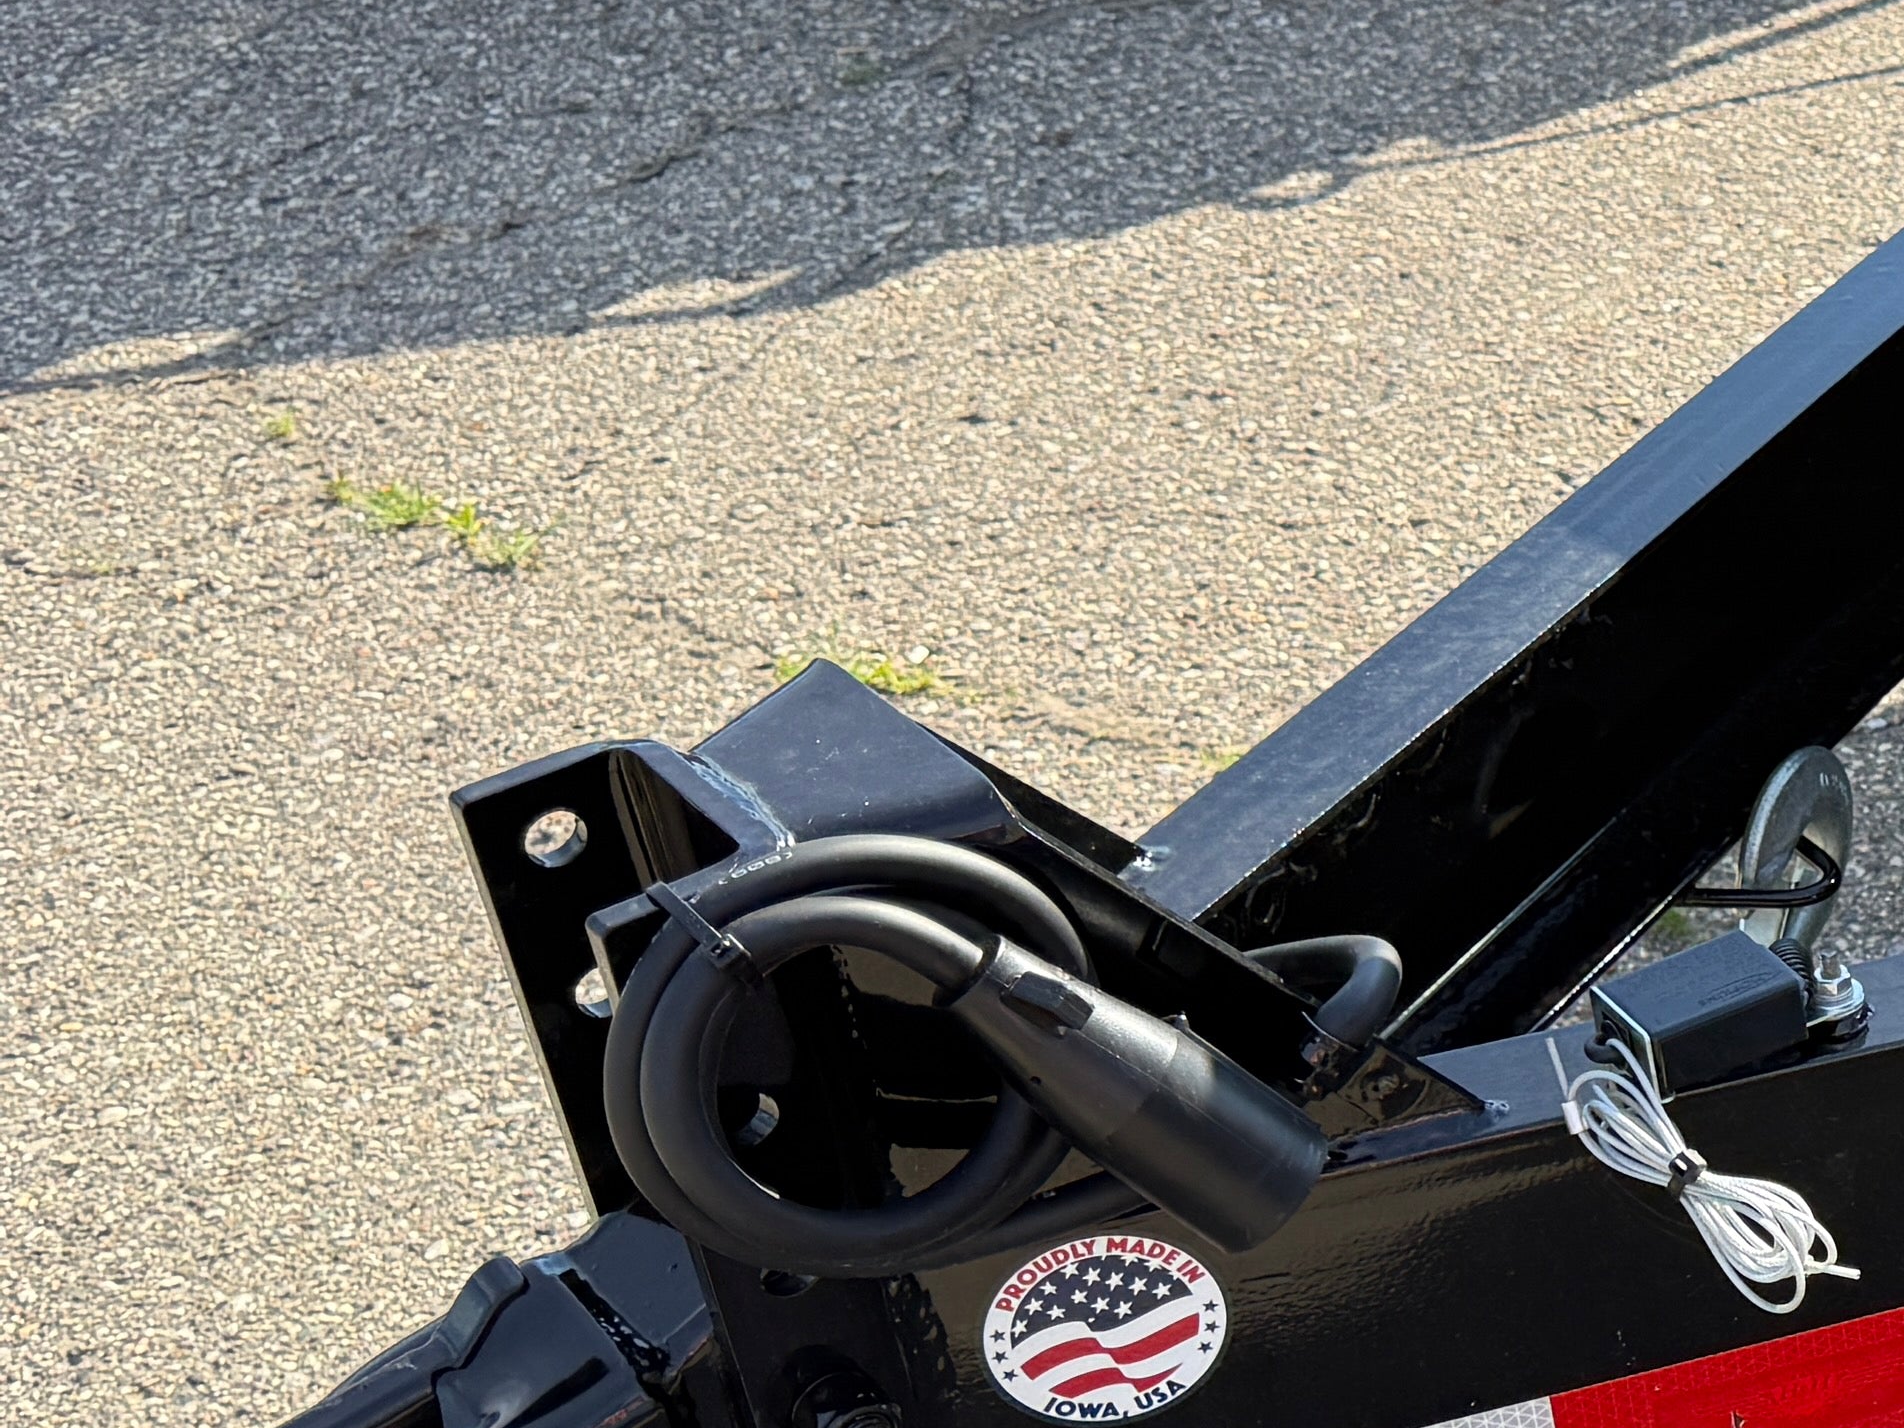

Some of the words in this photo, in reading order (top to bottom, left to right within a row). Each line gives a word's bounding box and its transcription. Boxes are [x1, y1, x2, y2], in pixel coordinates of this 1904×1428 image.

[995, 1239, 1096, 1312] PROUDLY
[1106, 1237, 1182, 1266] MADE
[1175, 1258, 1205, 1284] IN
[1043, 1397, 1129, 1420] IOWA,
[1133, 1379, 1186, 1409] USA
